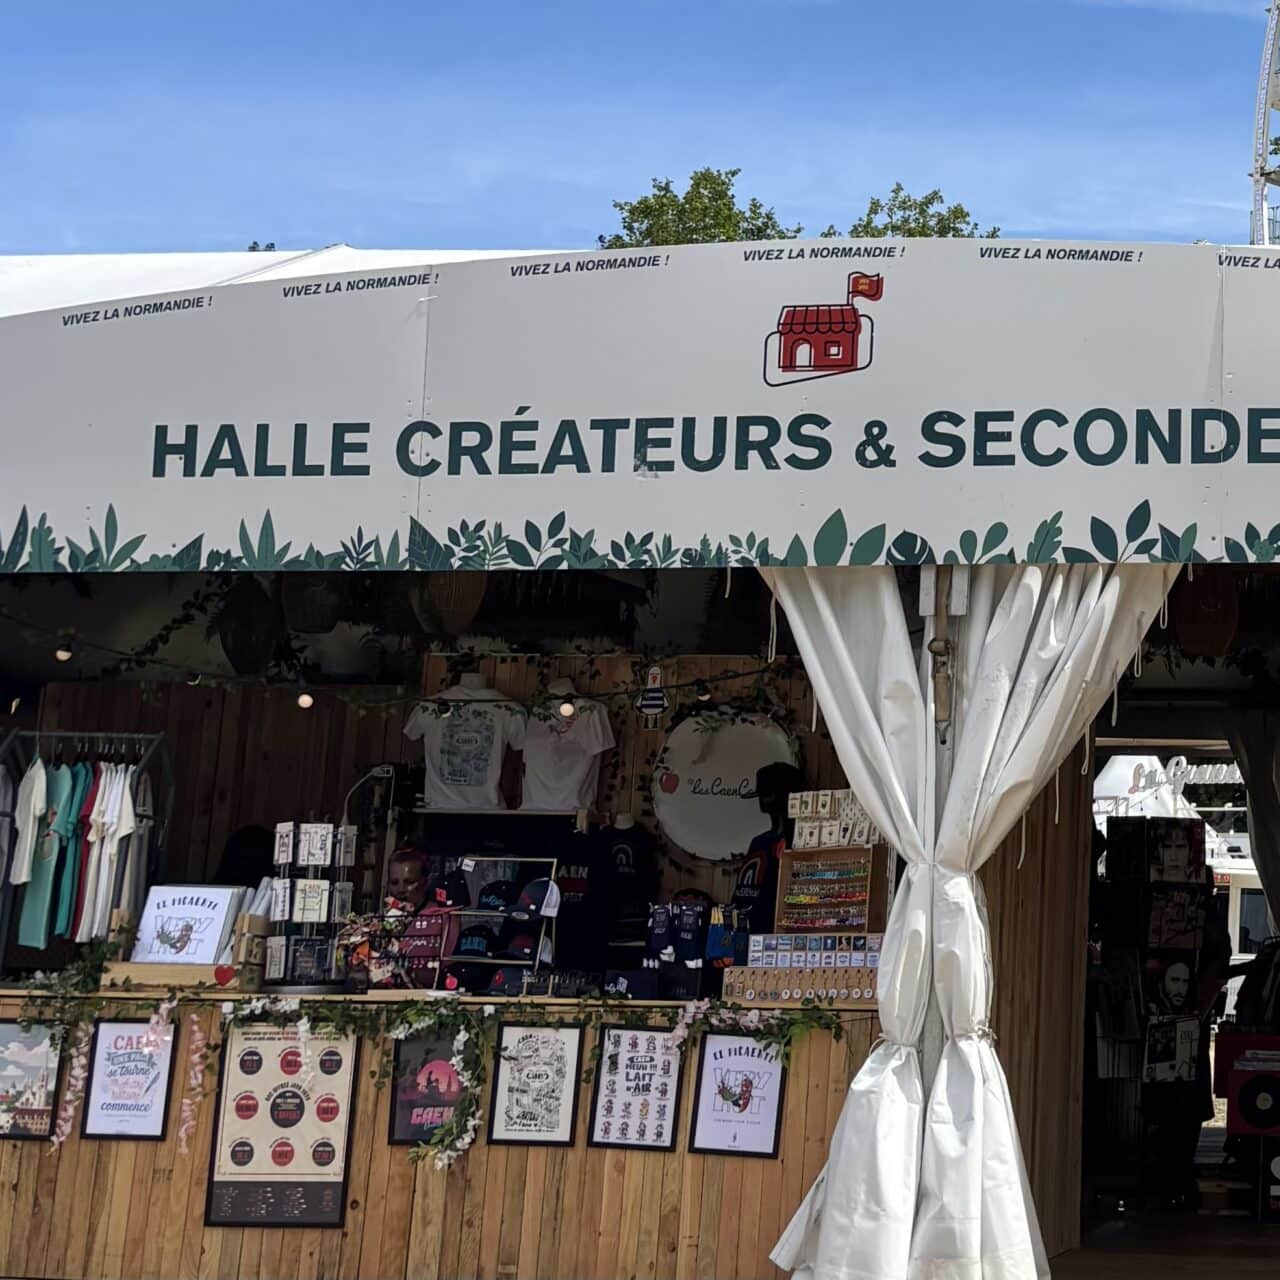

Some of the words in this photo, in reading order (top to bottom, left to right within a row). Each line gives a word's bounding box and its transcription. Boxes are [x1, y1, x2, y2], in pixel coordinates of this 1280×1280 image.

[743, 248, 785, 262] VIVEZ
[787, 247, 805, 260] LA
[808, 246, 897, 260] NORMANDIE
[979, 247, 1021, 259] VIVEZ
[1023, 247, 1042, 260] LA
[1045, 248, 1135, 263] NORMANDIE
[1218, 254, 1262, 269] VIVEZ
[510, 263, 552, 277] VIVEZ
[553, 261, 571, 274] LA
[574, 255, 662, 272] NORMANDIE
[282, 282, 322, 299] VIVEZ
[324, 281, 342, 294] LA
[345, 272, 432, 292] NORMANDIE
[61, 310, 101, 327] VIVEZ
[103, 307, 120, 321] LA
[123, 296, 205, 318] NORMANDIE
[152, 422, 371, 478] HALLE
[395, 405, 832, 478] CRÉATEURS
[854, 418, 897, 471] &
[624, 1071, 656, 1084] LAIT
[100, 1101, 151, 1113] commence
